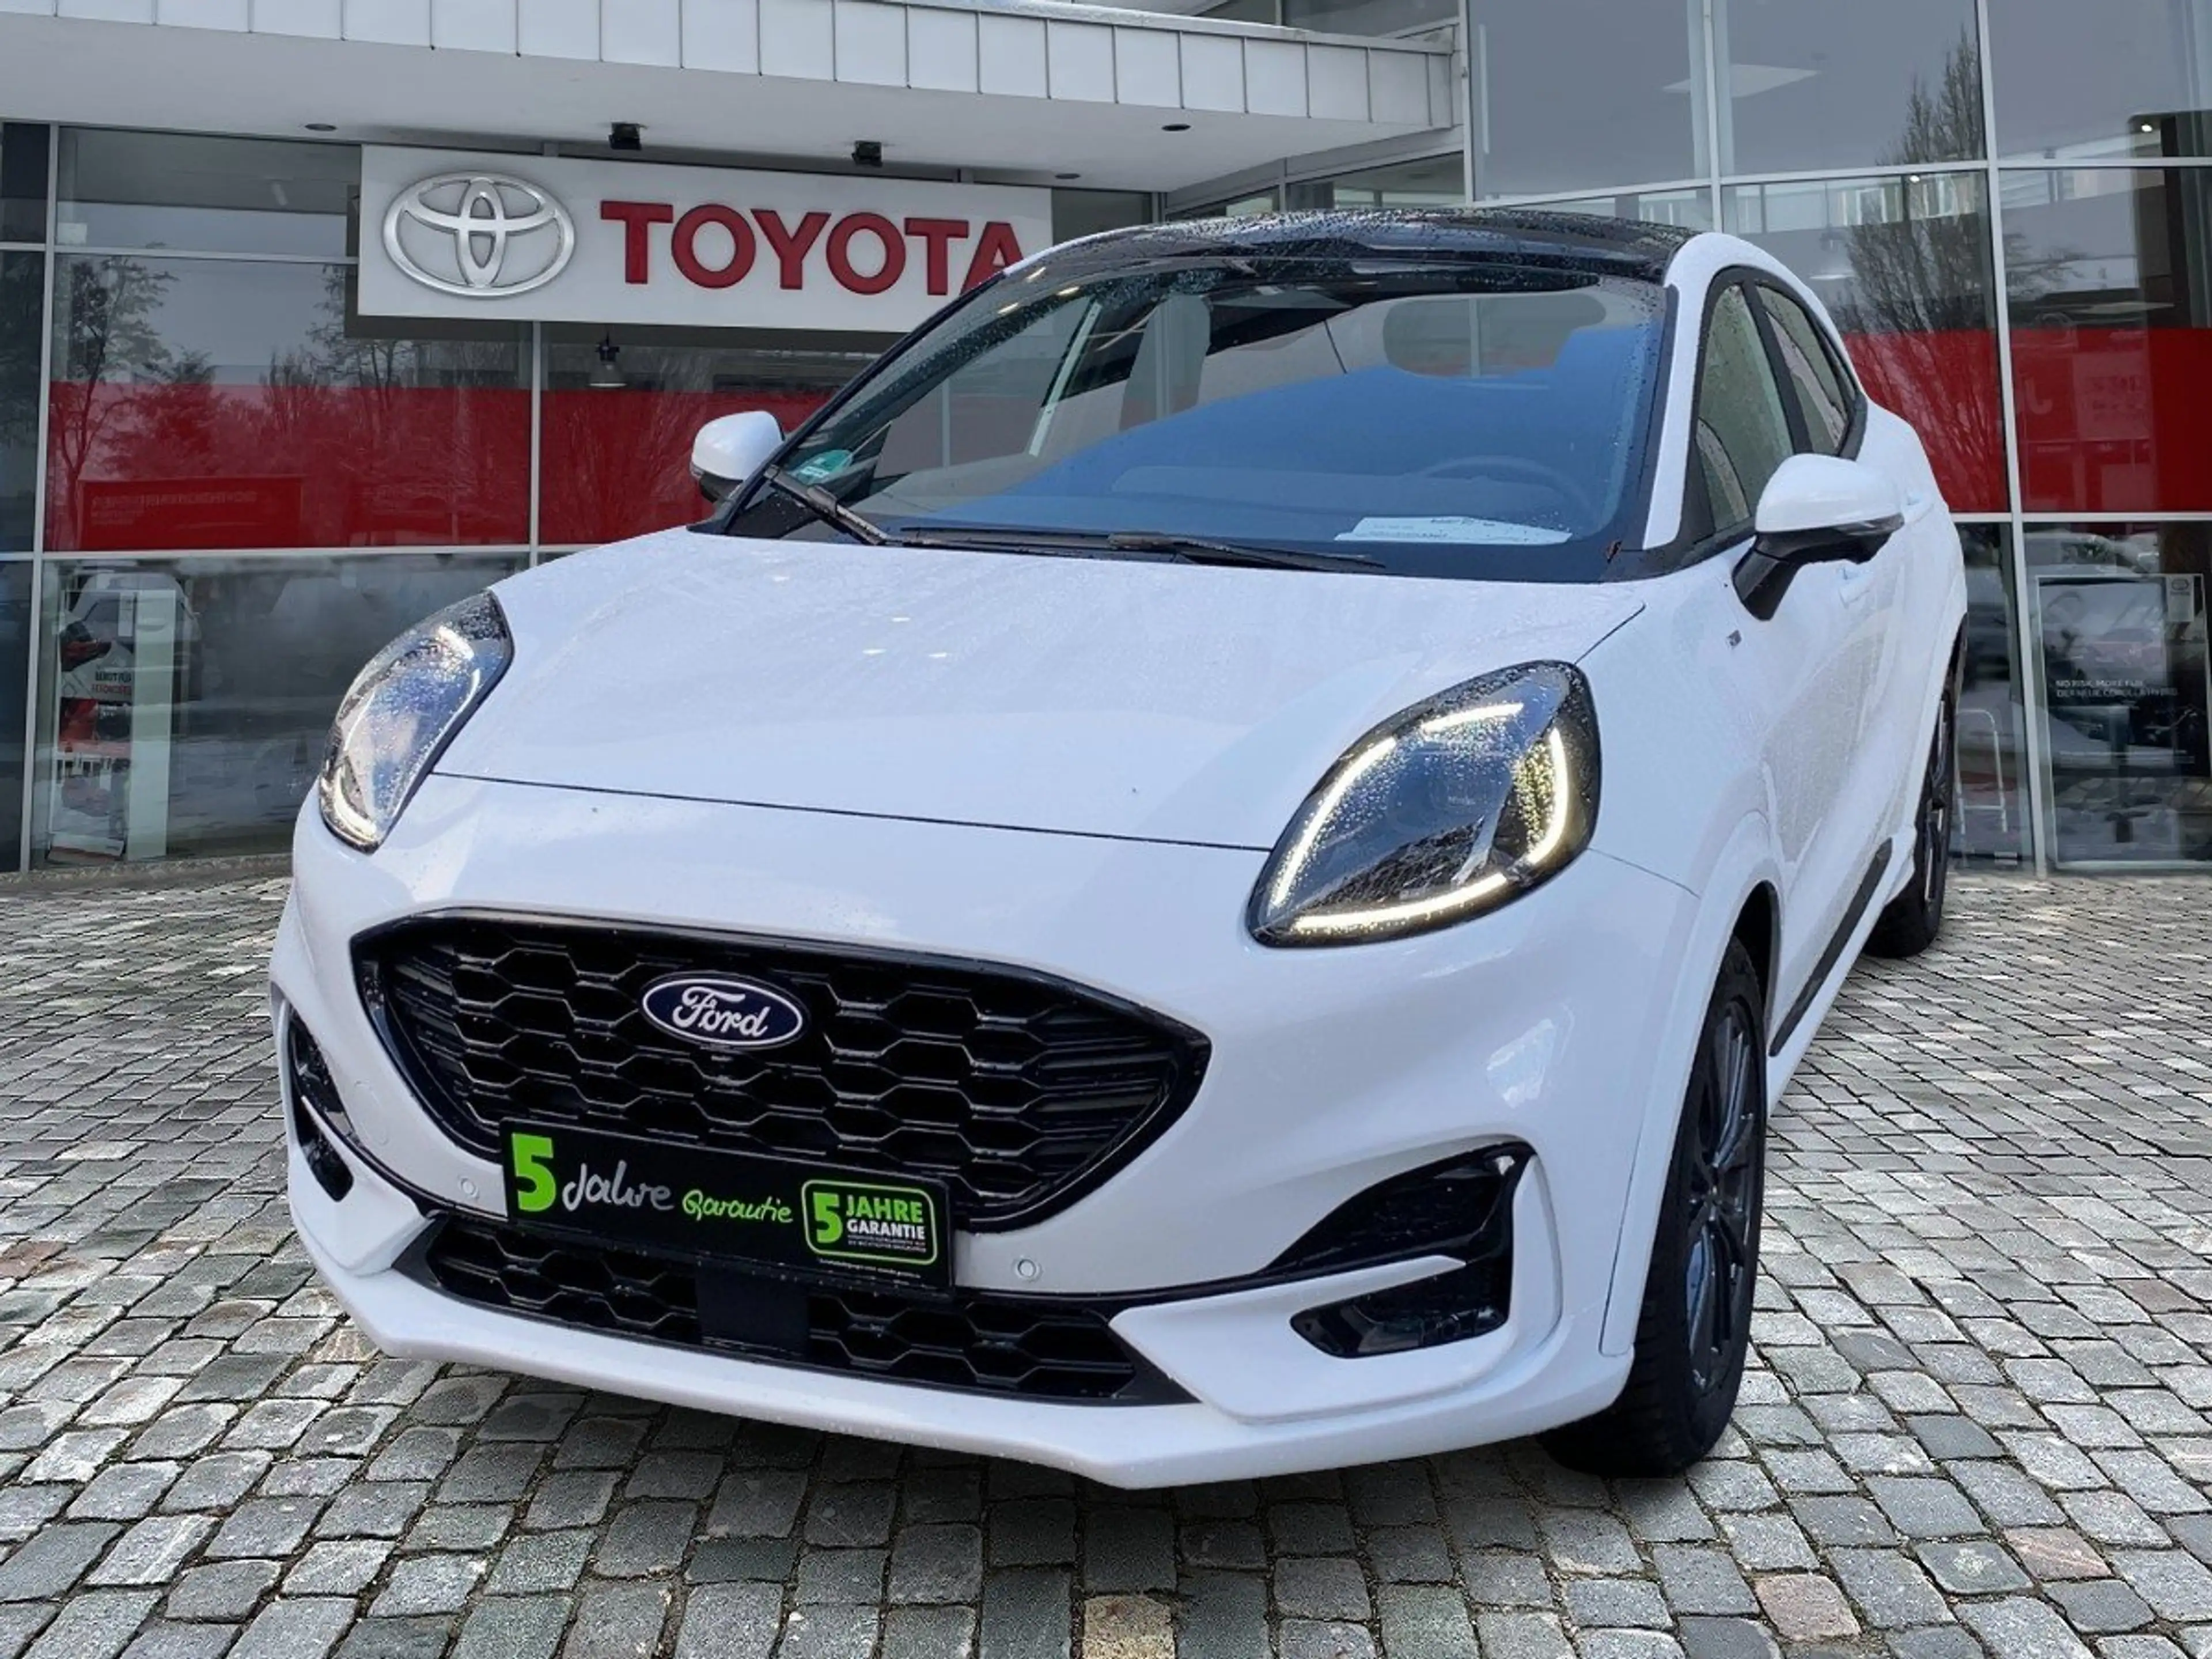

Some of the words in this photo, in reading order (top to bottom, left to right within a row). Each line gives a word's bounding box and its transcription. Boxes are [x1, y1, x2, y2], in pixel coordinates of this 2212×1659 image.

[600, 200, 1024, 296] TOYOTA
[672, 986, 771, 1037] Ford
[512, 1132, 556, 1212] 5
[562, 1160, 675, 1211] Jahre
[813, 1191, 843, 1244] 5
[846, 1194, 924, 1224] JAHRE
[846, 1218, 925, 1240] GARANTIE
